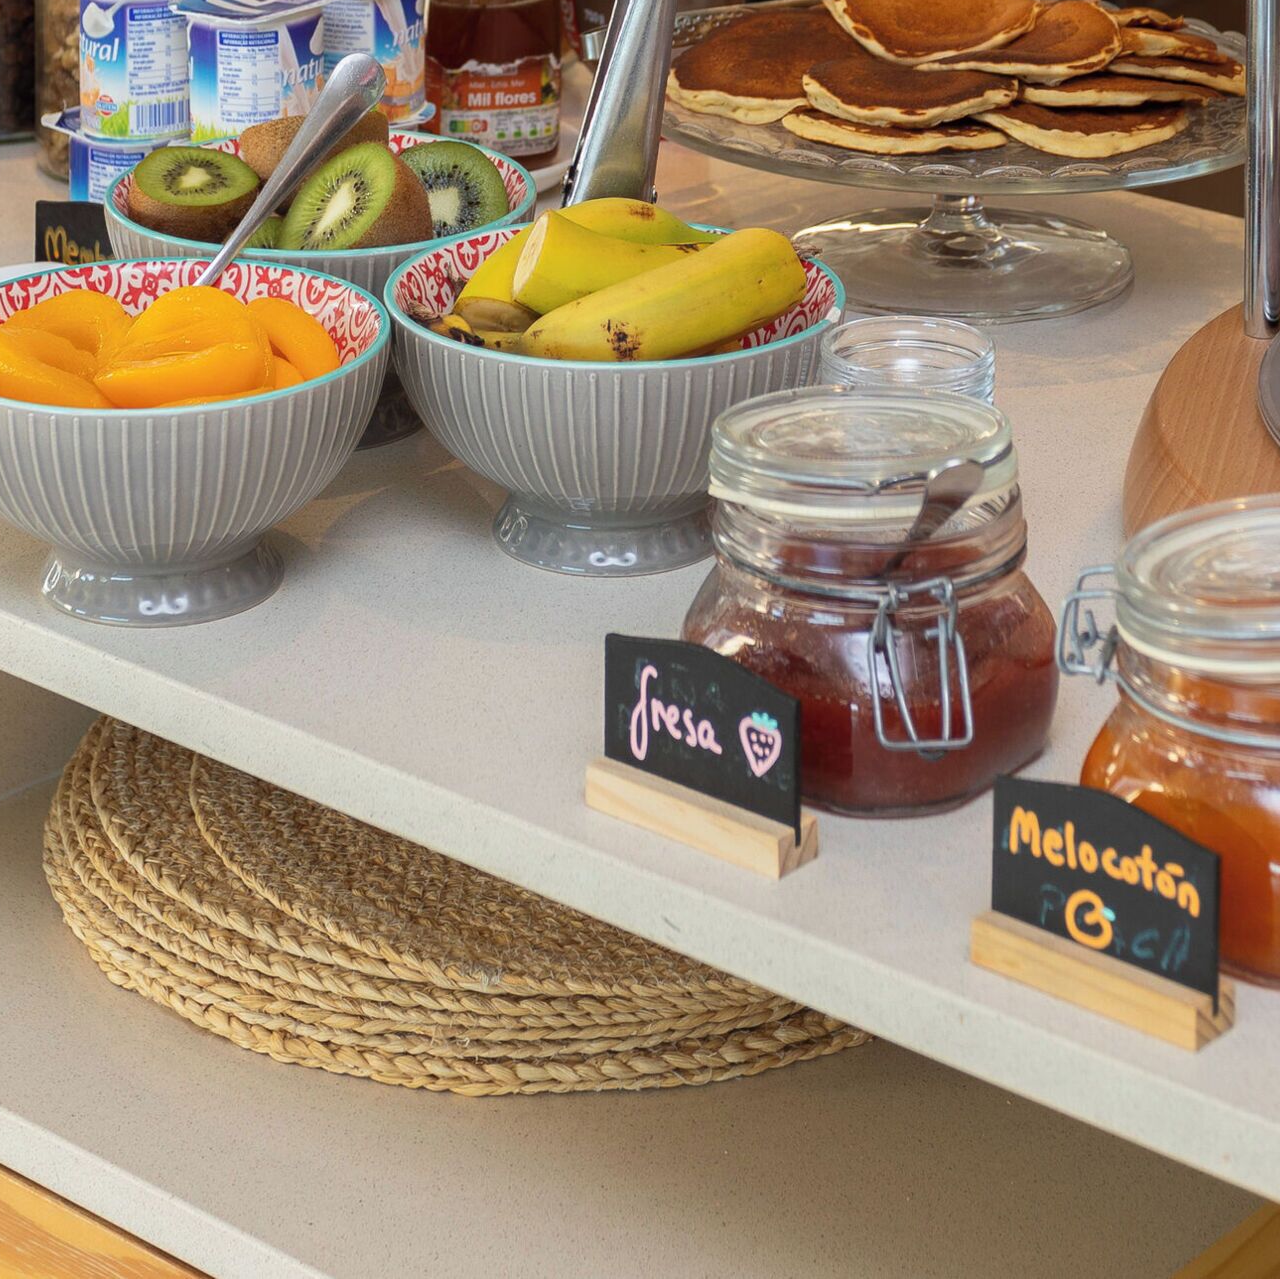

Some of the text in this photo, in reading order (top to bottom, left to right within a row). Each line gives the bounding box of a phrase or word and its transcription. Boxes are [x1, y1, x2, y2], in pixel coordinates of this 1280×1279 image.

[467, 91, 538, 107] Mil flores
[1009, 805, 1201, 918] Melocotón
